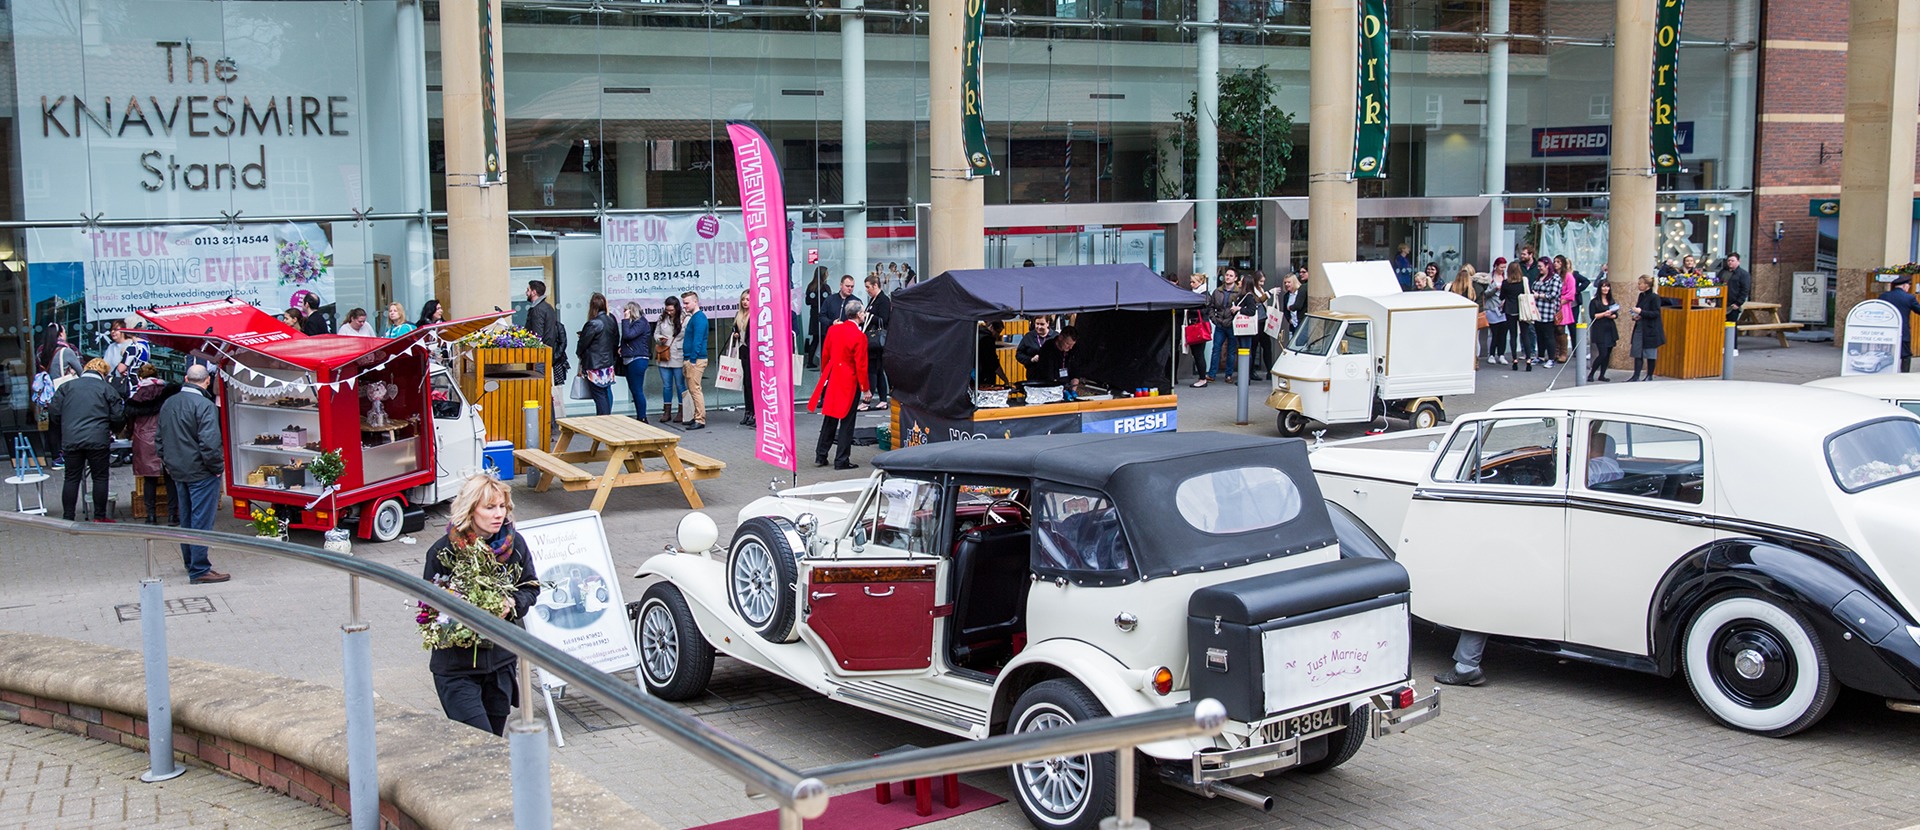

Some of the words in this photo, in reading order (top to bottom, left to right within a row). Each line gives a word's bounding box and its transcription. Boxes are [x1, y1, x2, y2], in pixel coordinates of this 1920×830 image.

[156, 37, 239, 83] The
[40, 95, 349, 138] KNAVESMIRE
[1541, 133, 1607, 149] BETFRED
[140, 145, 267, 191] Stand
[195, 236, 220, 246] 0113
[222, 235, 269, 245] 8214544
[607, 219, 643, 242] THE
[644, 219, 668, 242] UK
[89, 231, 132, 257] THE
[137, 230, 169, 257] UK
[607, 241, 692, 269] WEDDING
[695, 241, 748, 265] EVENT
[90, 257, 201, 287] WEDDING
[205, 255, 272, 283] EVENT
[626, 272, 650, 282] 0113
[653, 270, 700, 281] 8214544
[1114, 413, 1168, 434] FRESH
[531, 548, 568, 561] Wedding
[568, 542, 588, 555] Cars
[533, 531, 577, 547] Wharfedale
[1307, 656, 1329, 675] Just
[1331, 648, 1368, 664] Married
[1291, 709, 1334, 734] 3384
